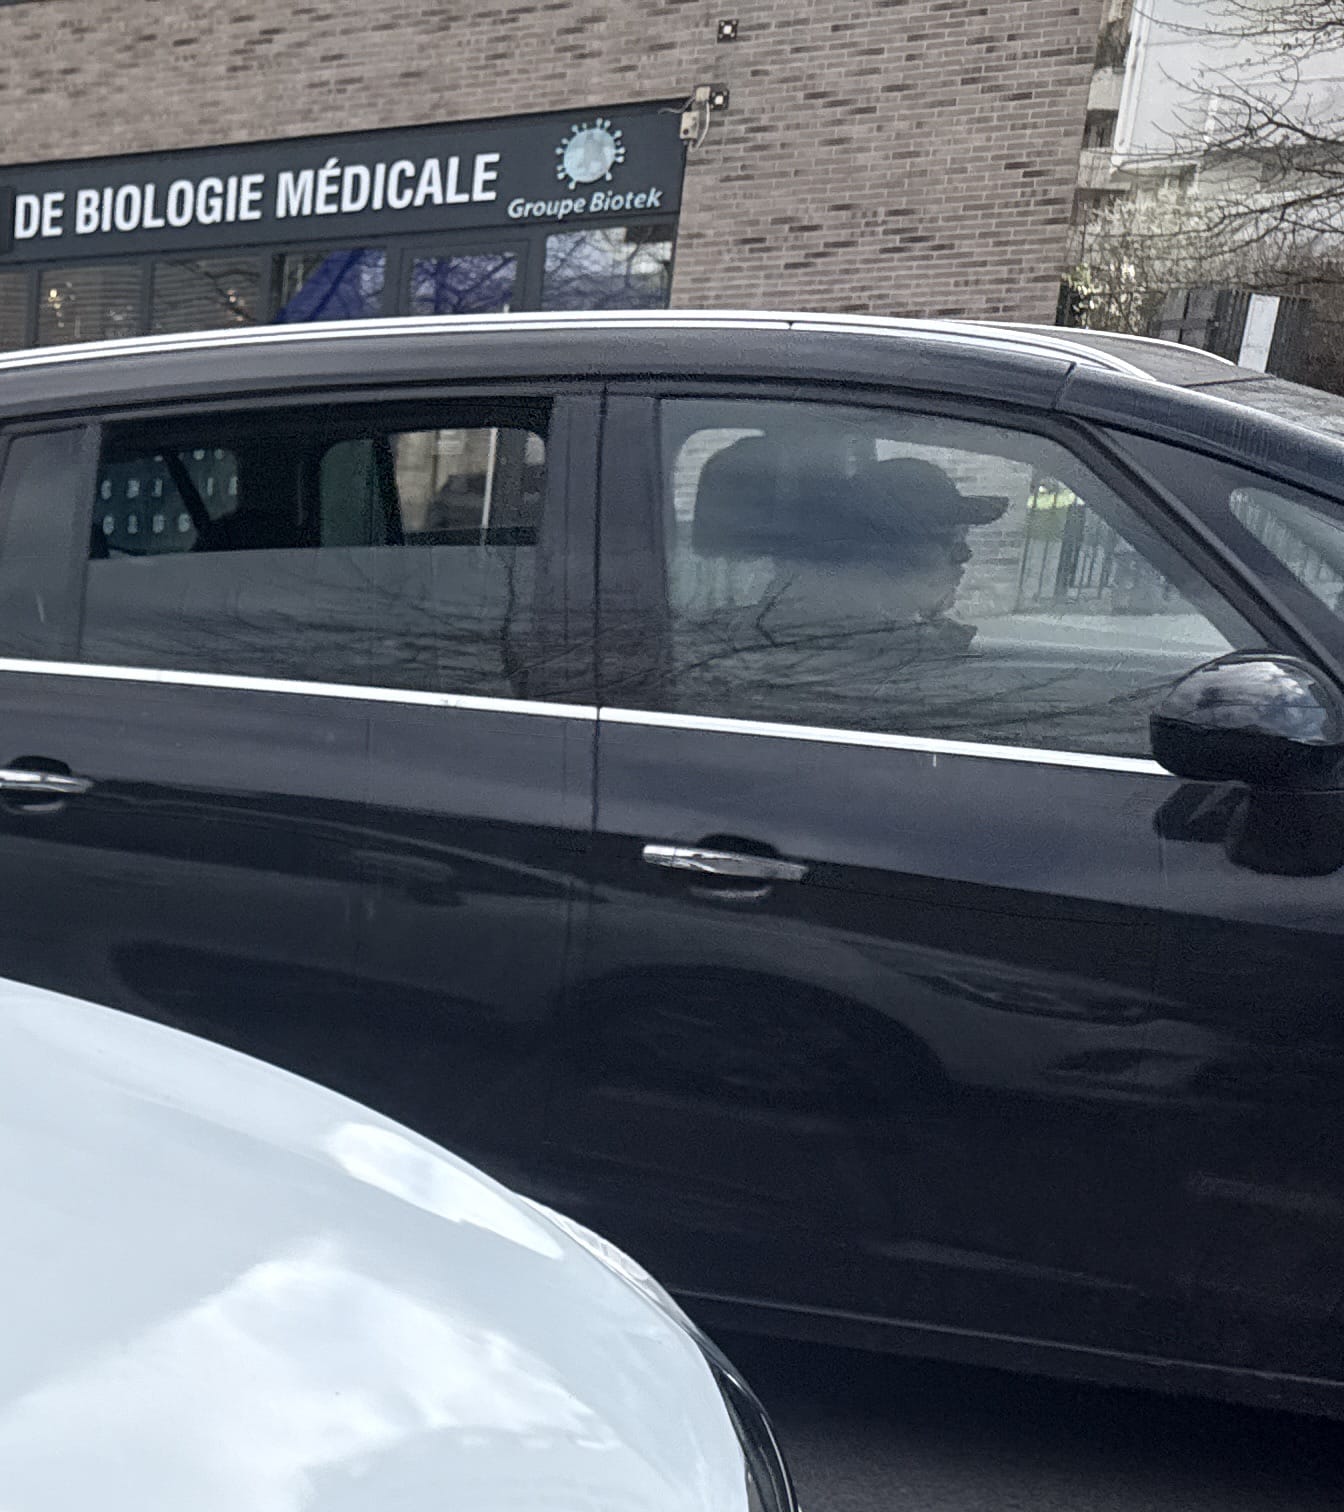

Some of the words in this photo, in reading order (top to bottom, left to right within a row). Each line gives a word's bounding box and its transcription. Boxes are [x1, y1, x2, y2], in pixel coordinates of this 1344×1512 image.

[14, 191, 64, 240] DE
[75, 172, 265, 235] BIOLOGIE
[275, 152, 500, 219] MÉDICALE
[507, 197, 587, 220] Groupe
[589, 187, 663, 213] Biotek
